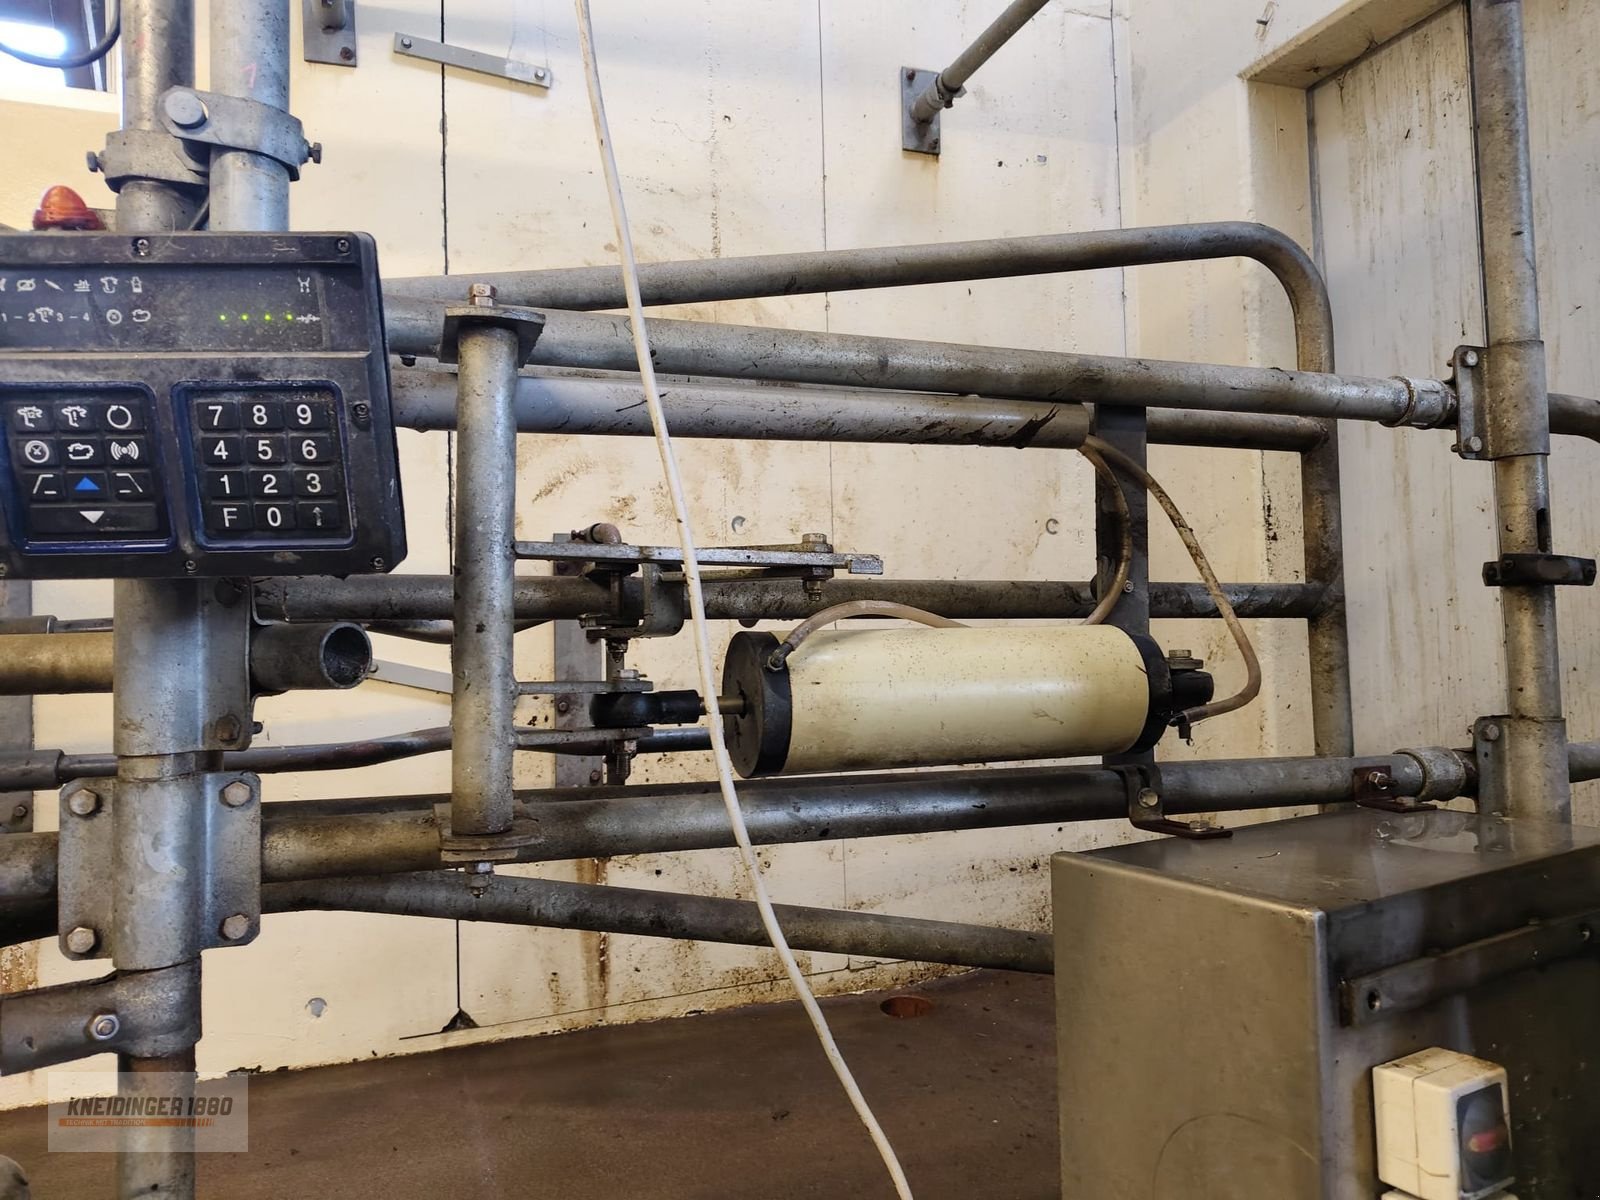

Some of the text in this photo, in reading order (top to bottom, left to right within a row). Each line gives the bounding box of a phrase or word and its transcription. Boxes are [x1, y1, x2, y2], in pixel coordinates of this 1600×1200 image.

[208, 403, 312, 426] 7 8 9
[213, 439, 318, 460] 4 5 6
[219, 472, 322, 494] 1 2 3
[222, 506, 282, 528] F 0
